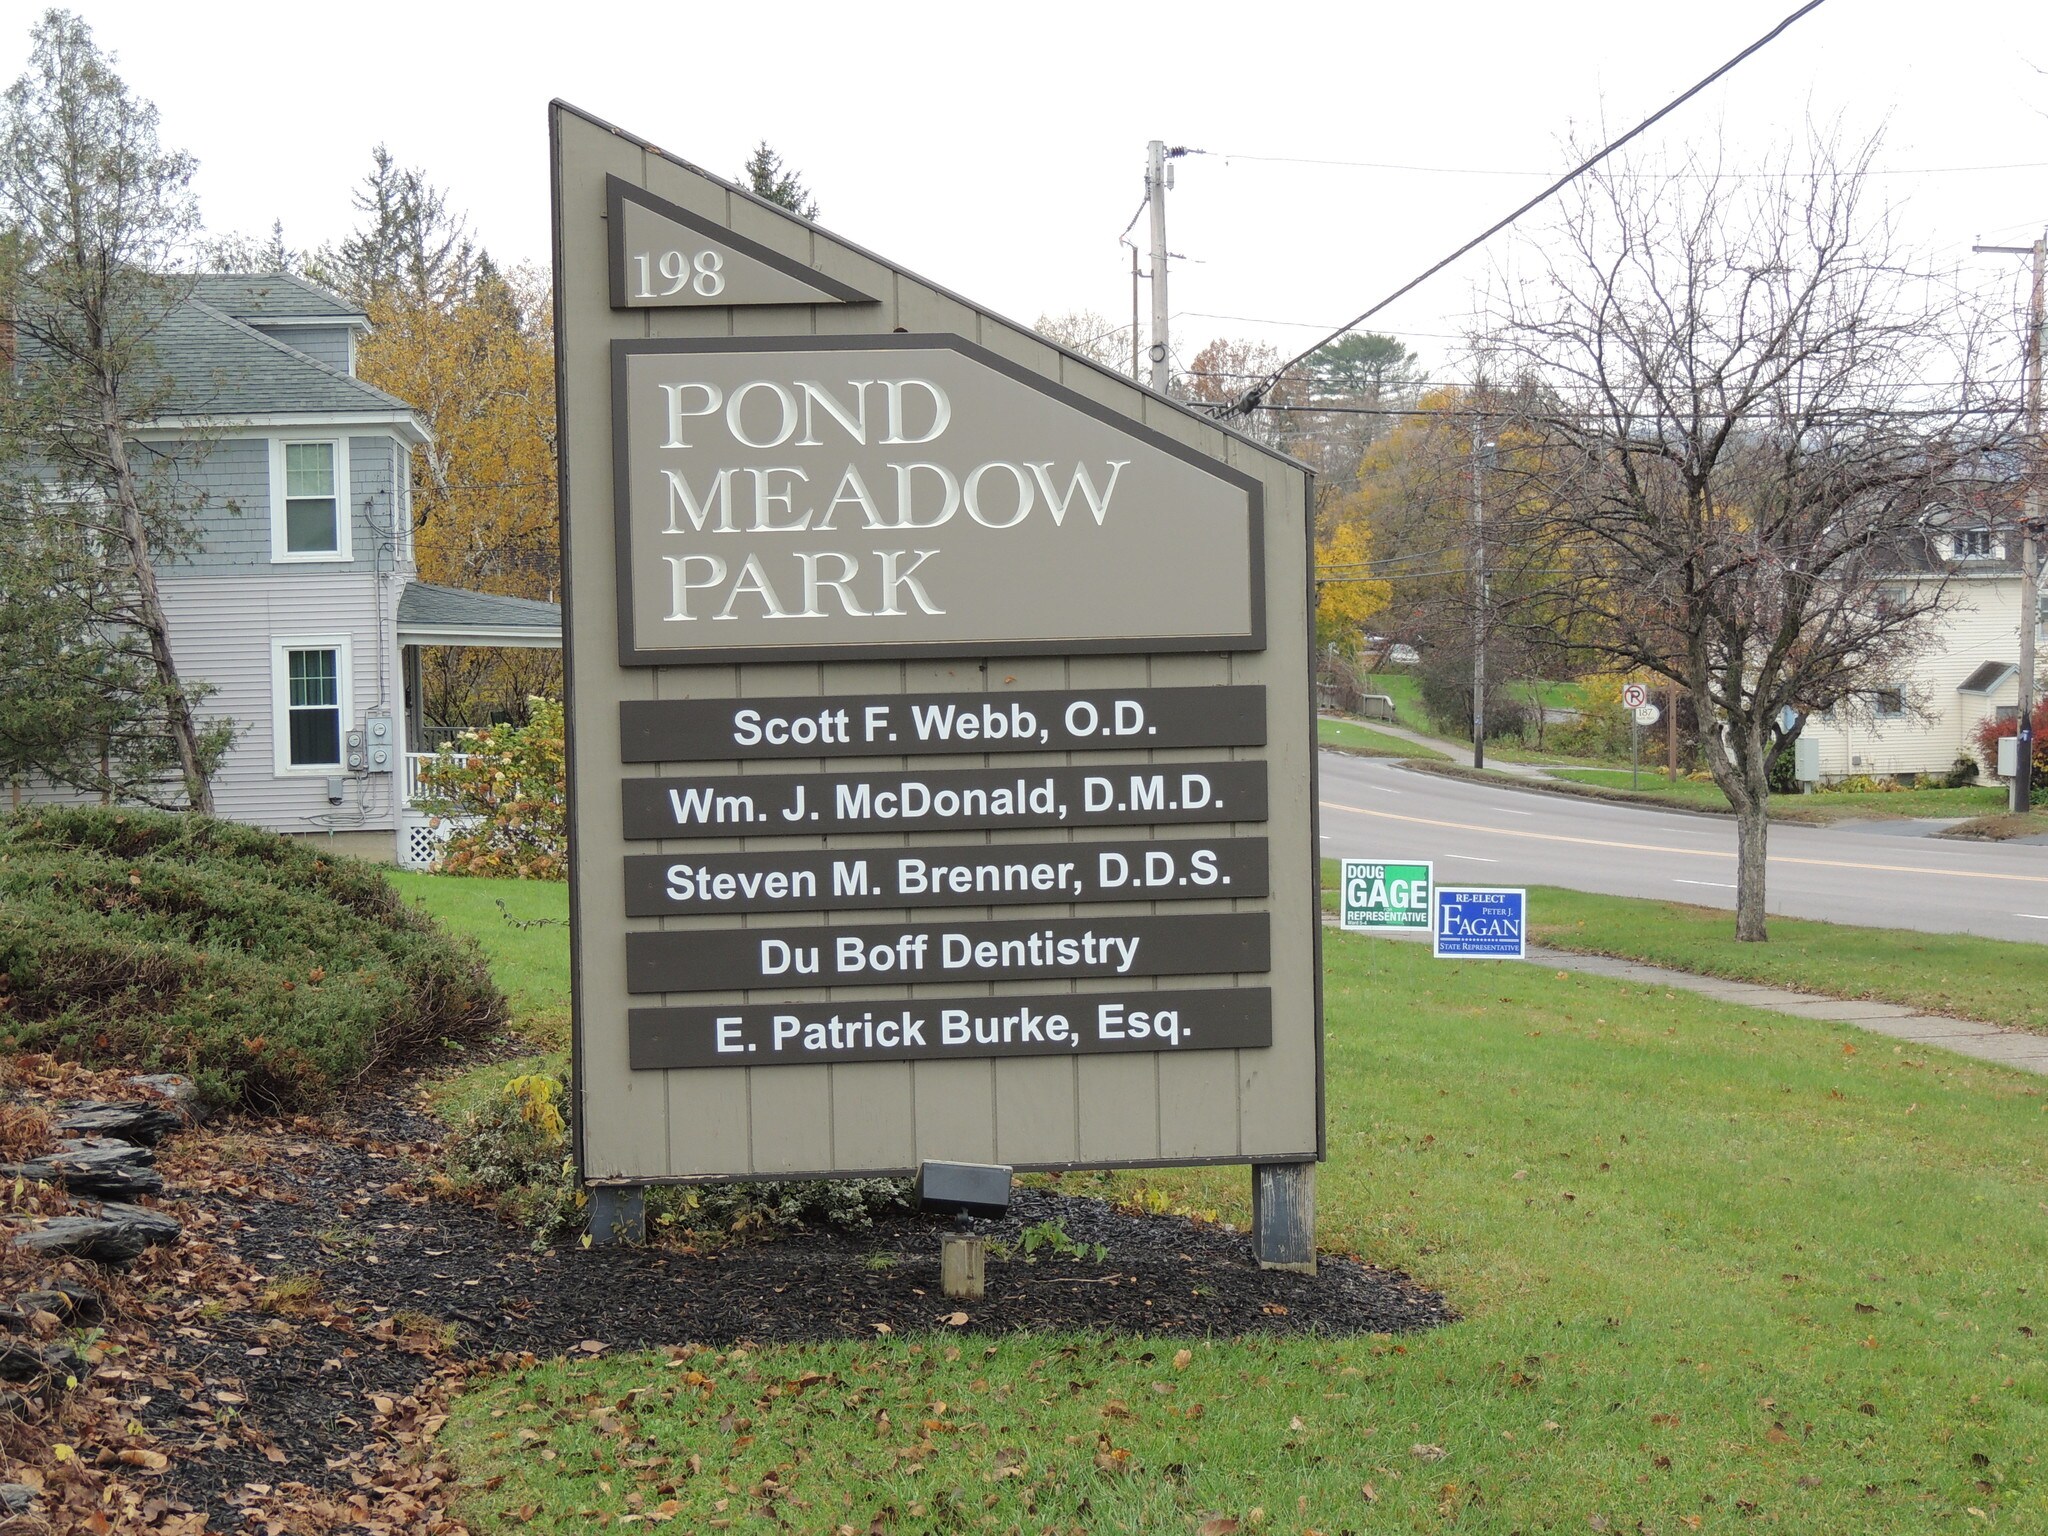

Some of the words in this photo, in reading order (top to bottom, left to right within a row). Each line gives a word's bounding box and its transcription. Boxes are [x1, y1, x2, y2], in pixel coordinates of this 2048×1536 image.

[633, 250, 726, 298] 198
[659, 378, 952, 449] POND
[661, 459, 1132, 535] MEADOW
[662, 548, 947, 622] PARK
[733, 709, 850, 746] Scott
[865, 706, 897, 742] F.
[912, 703, 1049, 745] Webb,
[1064, 700, 1157, 737] O.D.
[1639, 708, 1652, 717] 187
[669, 787, 767, 824] Wm.
[782, 785, 819, 822] J.
[836, 778, 1067, 820] McDonald,
[1084, 774, 1224, 812] D.M.D.
[666, 864, 817, 901] Steven
[833, 860, 881, 897] M.
[898, 858, 1082, 896] Brenner,
[1099, 850, 1231, 888] D.D.S.
[1347, 865, 1384, 879] DOUG
[1348, 879, 1427, 908] GAGE
[1347, 911, 1427, 922] REPRESENTATIVE
[1440, 904, 1520, 936] FAGAN
[1456, 894, 1505, 903] RE-ELECT
[1483, 907, 1506, 916] PETER
[1508, 908, 1513, 917] J.
[761, 939, 819, 975] Du
[836, 934, 929, 972] Boff
[942, 930, 1140, 973] Dentistry
[1462, 943, 1519, 951] REPRESENTATIVE
[716, 1016, 757, 1053] E.
[773, 1011, 927, 1051] Patrick
[941, 1007, 1079, 1048] Burke,
[1098, 1003, 1191, 1046] Esq.
